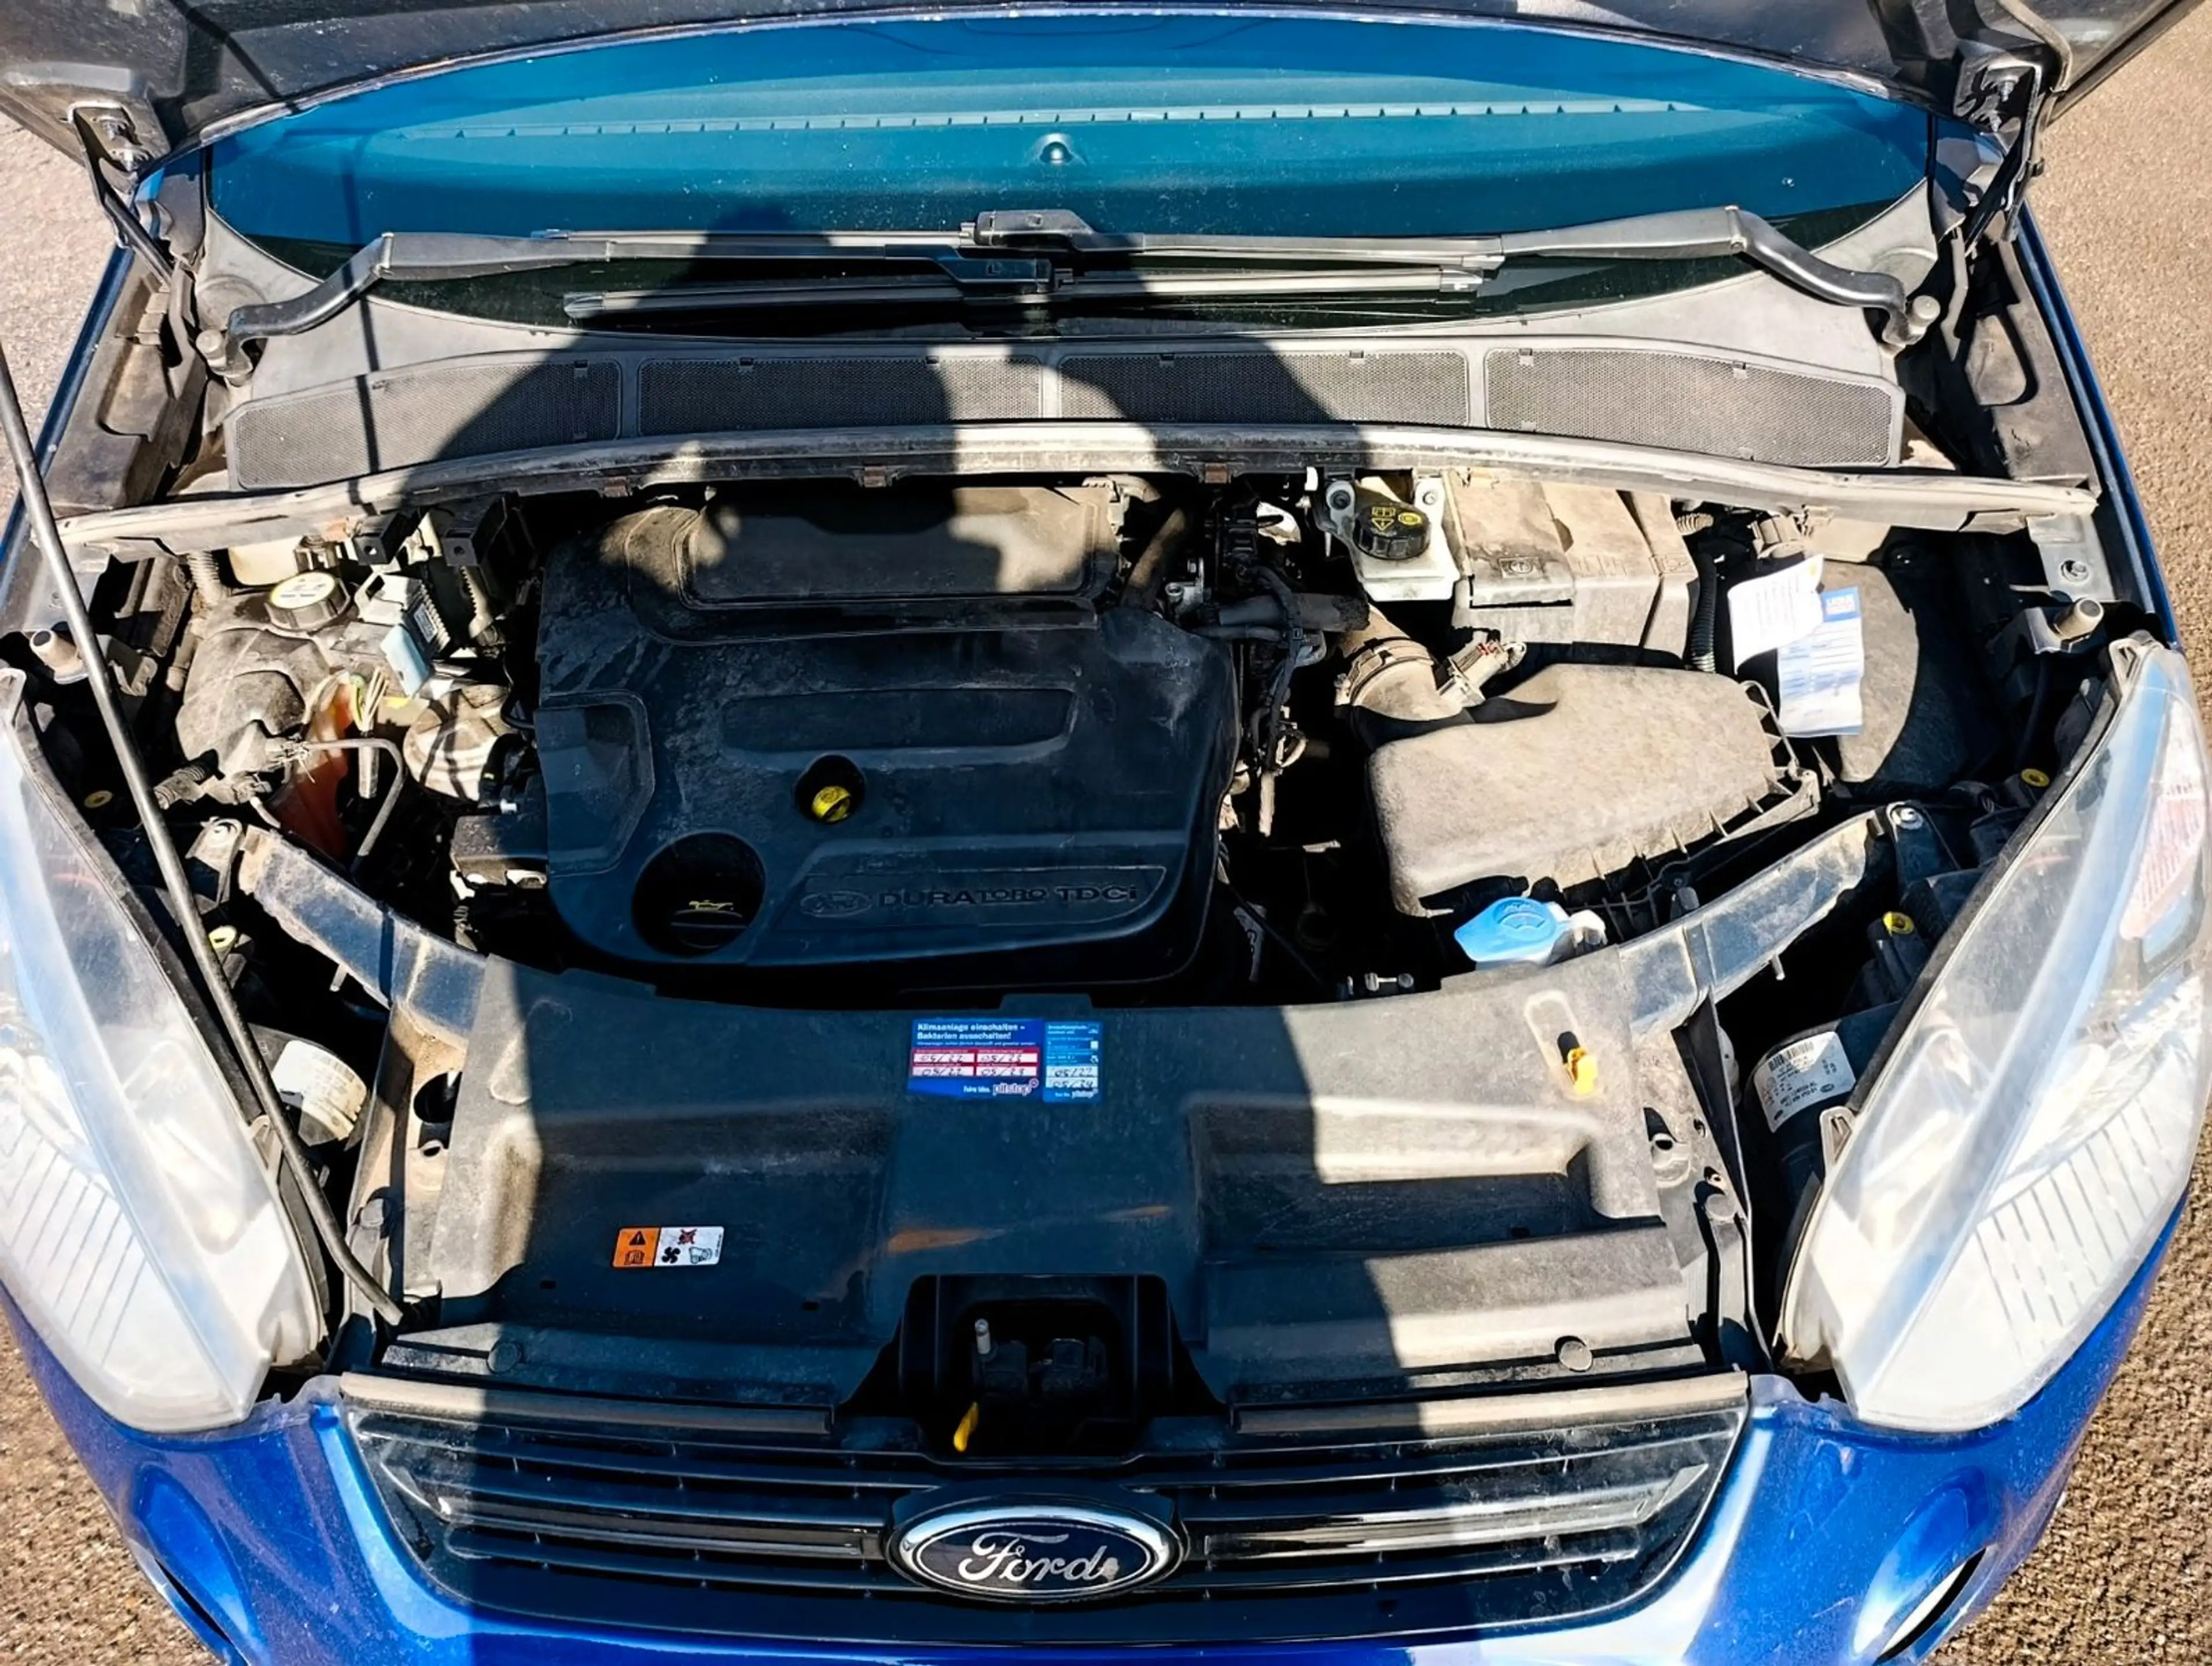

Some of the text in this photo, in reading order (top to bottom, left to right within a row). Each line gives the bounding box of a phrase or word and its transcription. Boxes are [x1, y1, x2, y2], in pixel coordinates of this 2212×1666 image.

[1057, 885, 1137, 902] TDCi
[917, 1023, 969, 1032] Klimaanlage
[958, 1532, 1107, 1582] Ford
